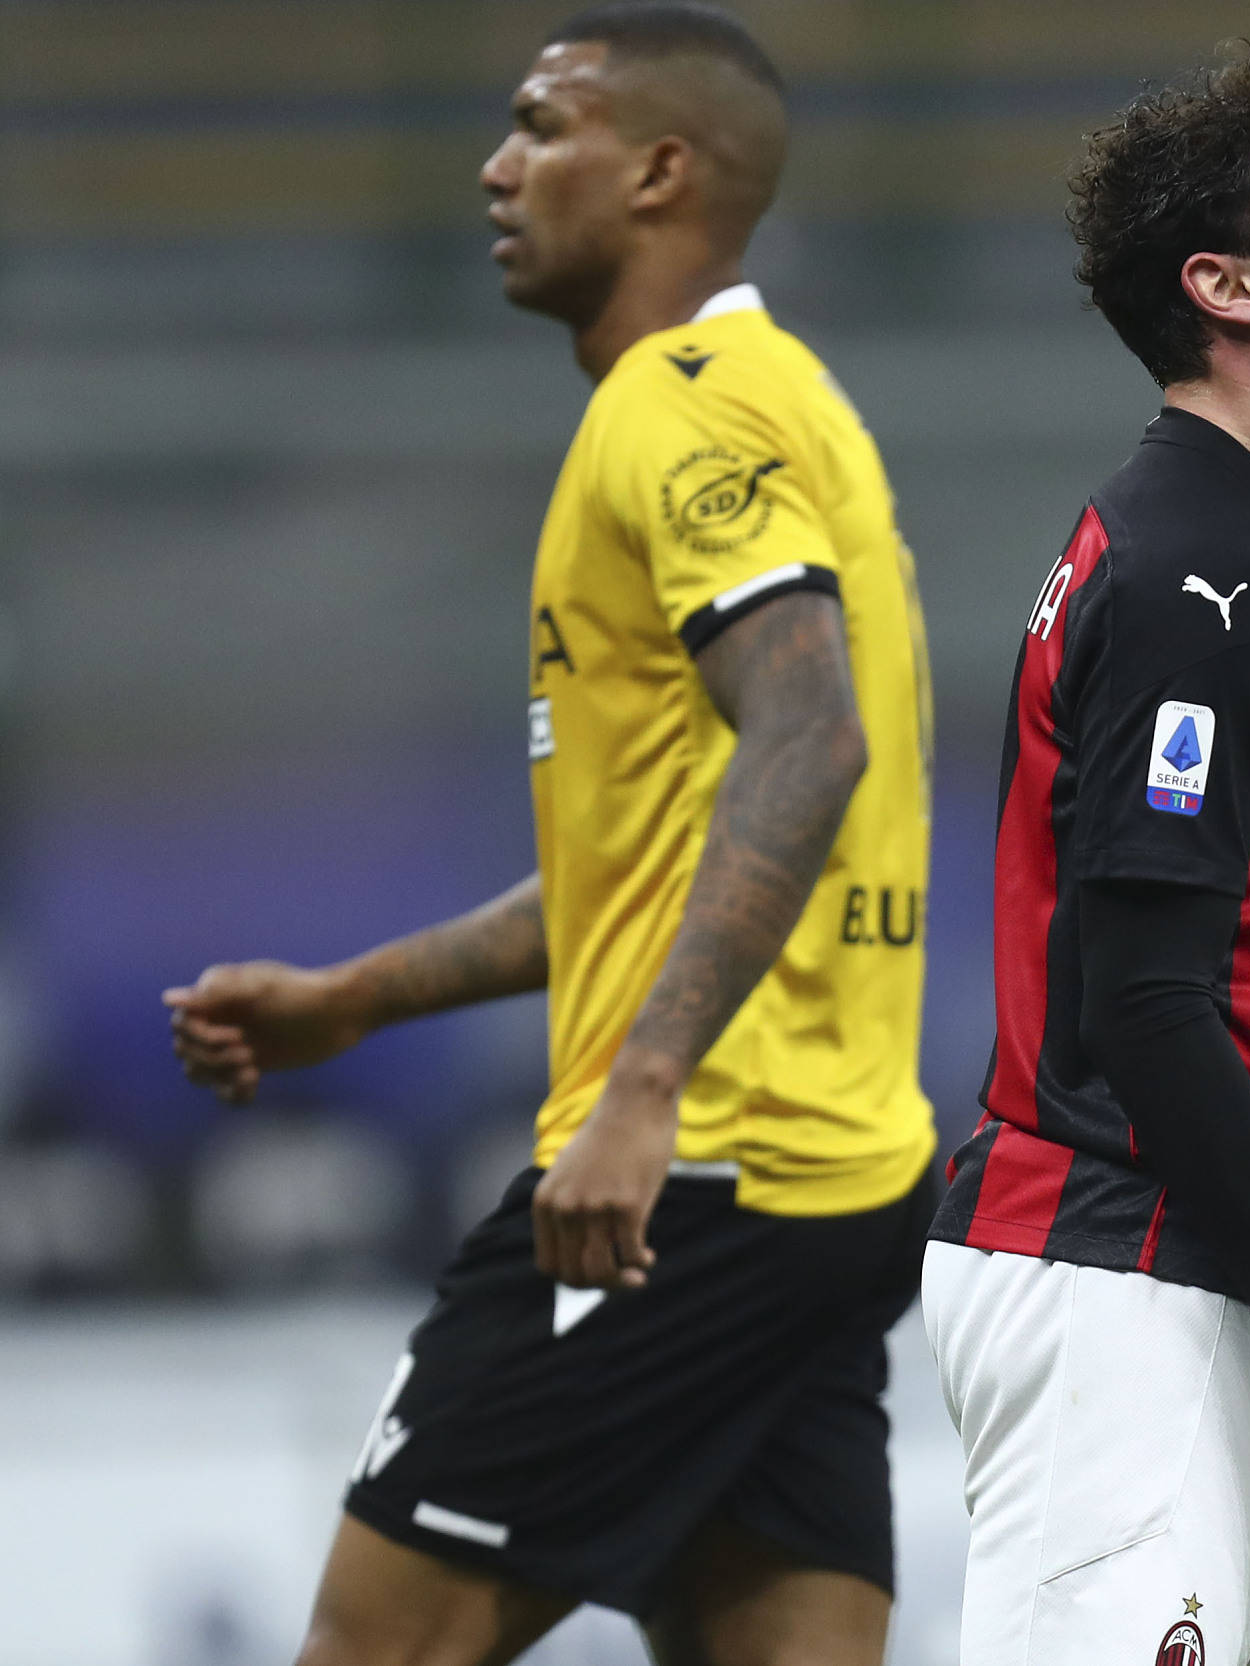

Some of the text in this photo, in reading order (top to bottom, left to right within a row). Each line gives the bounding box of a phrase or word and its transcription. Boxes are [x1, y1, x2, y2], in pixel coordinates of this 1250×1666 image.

[1156, 773, 1200, 790] SERIE A
[1172, 793, 1199, 811] TIM
[1172, 1629, 1198, 1650] ACM
